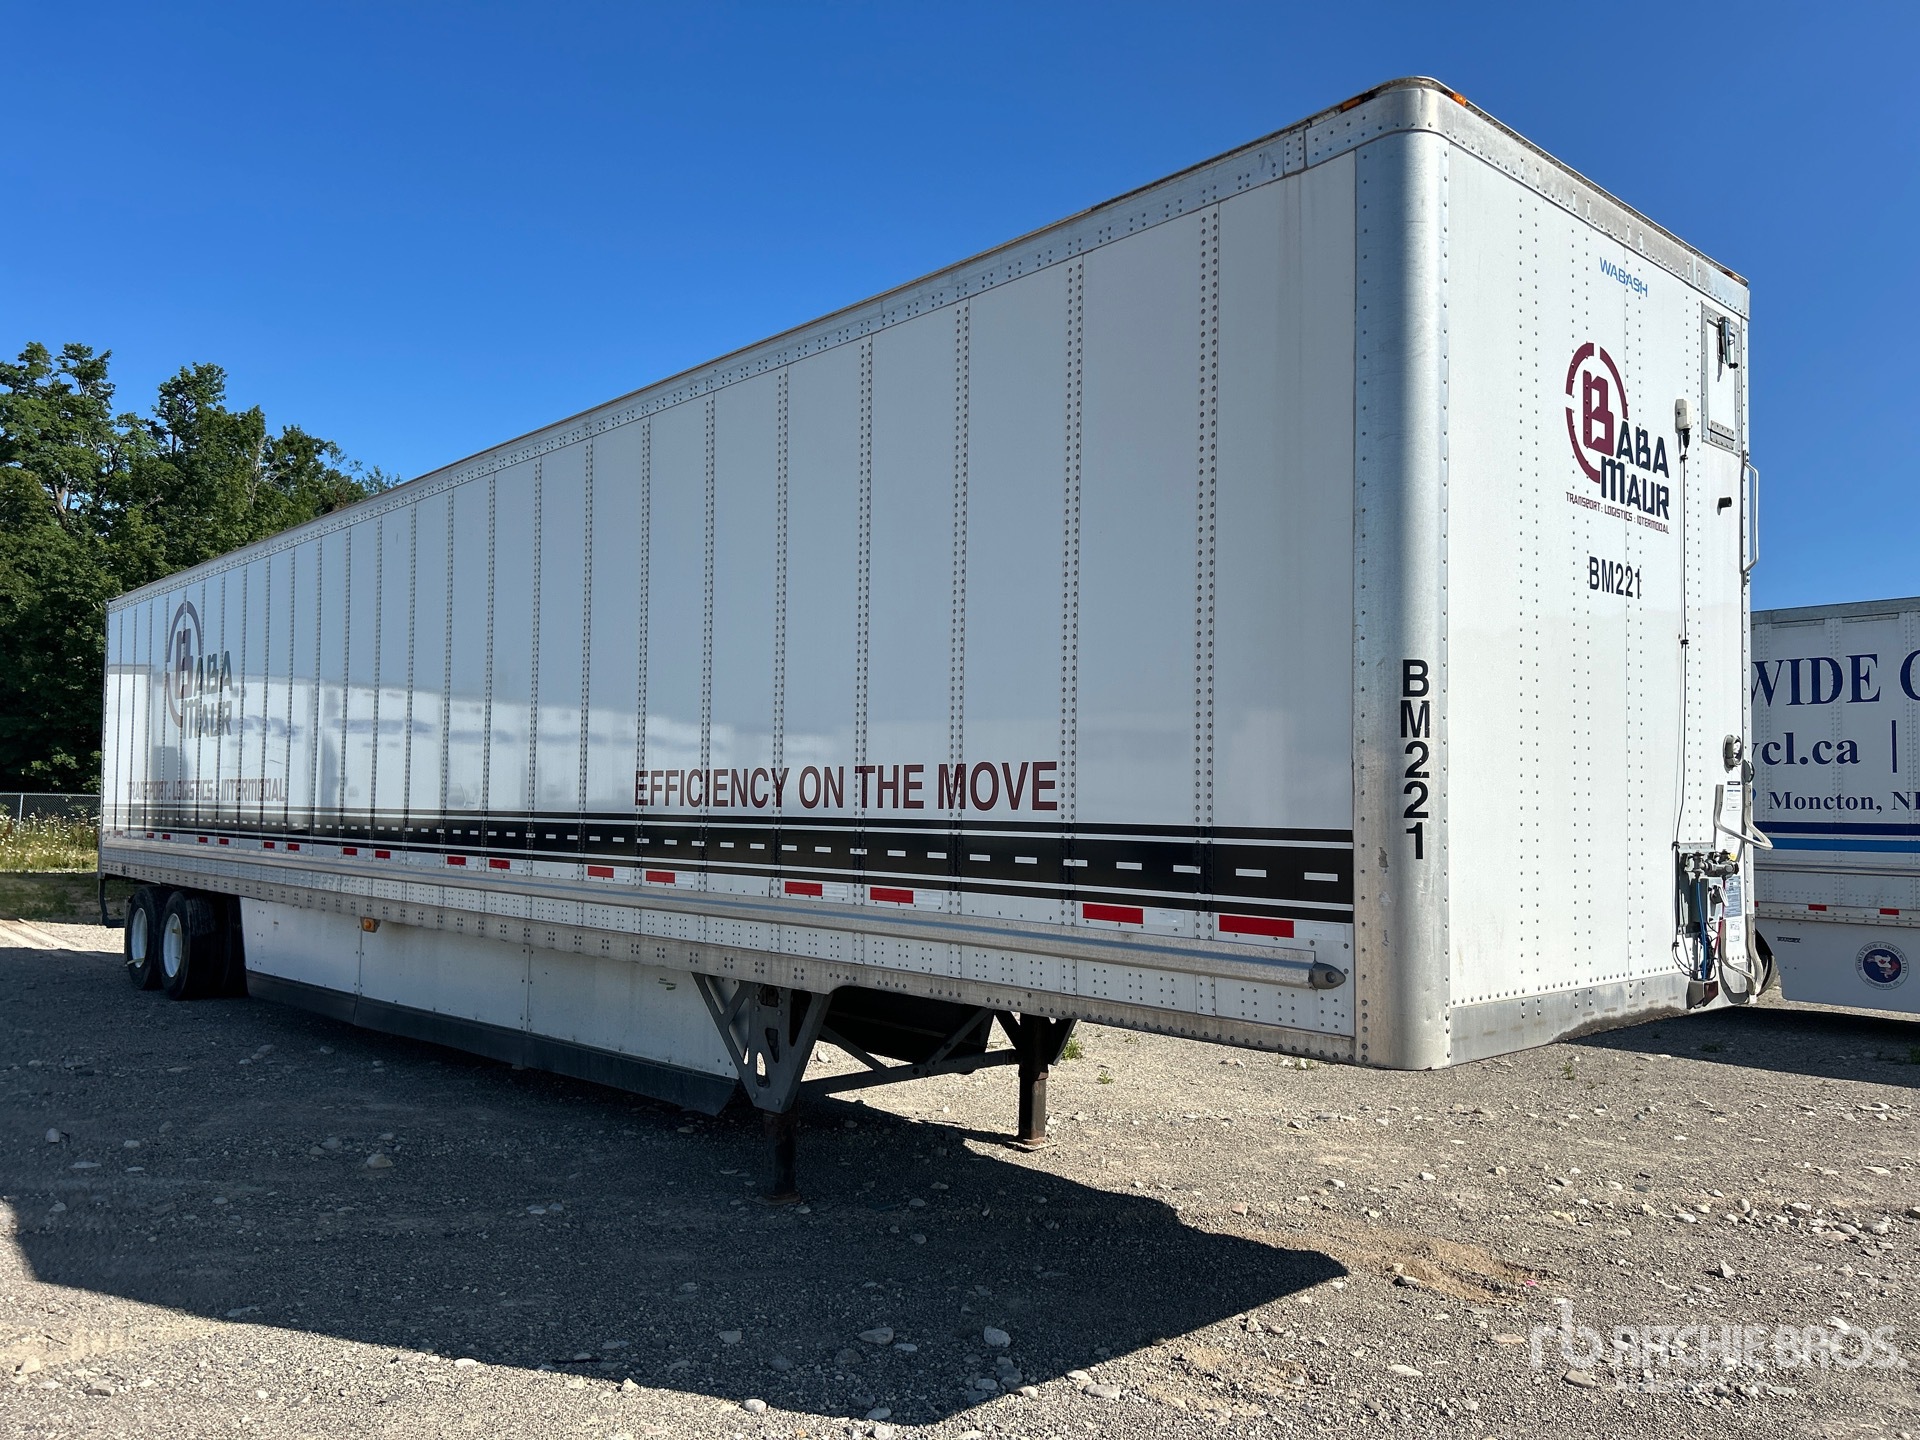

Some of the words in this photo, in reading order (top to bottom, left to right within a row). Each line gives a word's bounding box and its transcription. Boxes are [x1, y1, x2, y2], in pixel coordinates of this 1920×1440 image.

[1599, 257, 1648, 298] WABASH
[1601, 456, 1669, 521] MAUR
[1589, 556, 1641, 600] BM221
[1752, 654, 1881, 707] WIDE
[182, 699, 232, 740] MAUR
[1752, 732, 1861, 765] cl.ca
[635, 767, 789, 807] EFFICIENCY
[799, 765, 845, 809] ON
[855, 764, 925, 809] THE
[937, 761, 1058, 811] MOVE
[1768, 791, 1883, 814] Moncton,
[1891, 791, 1920, 811] N
